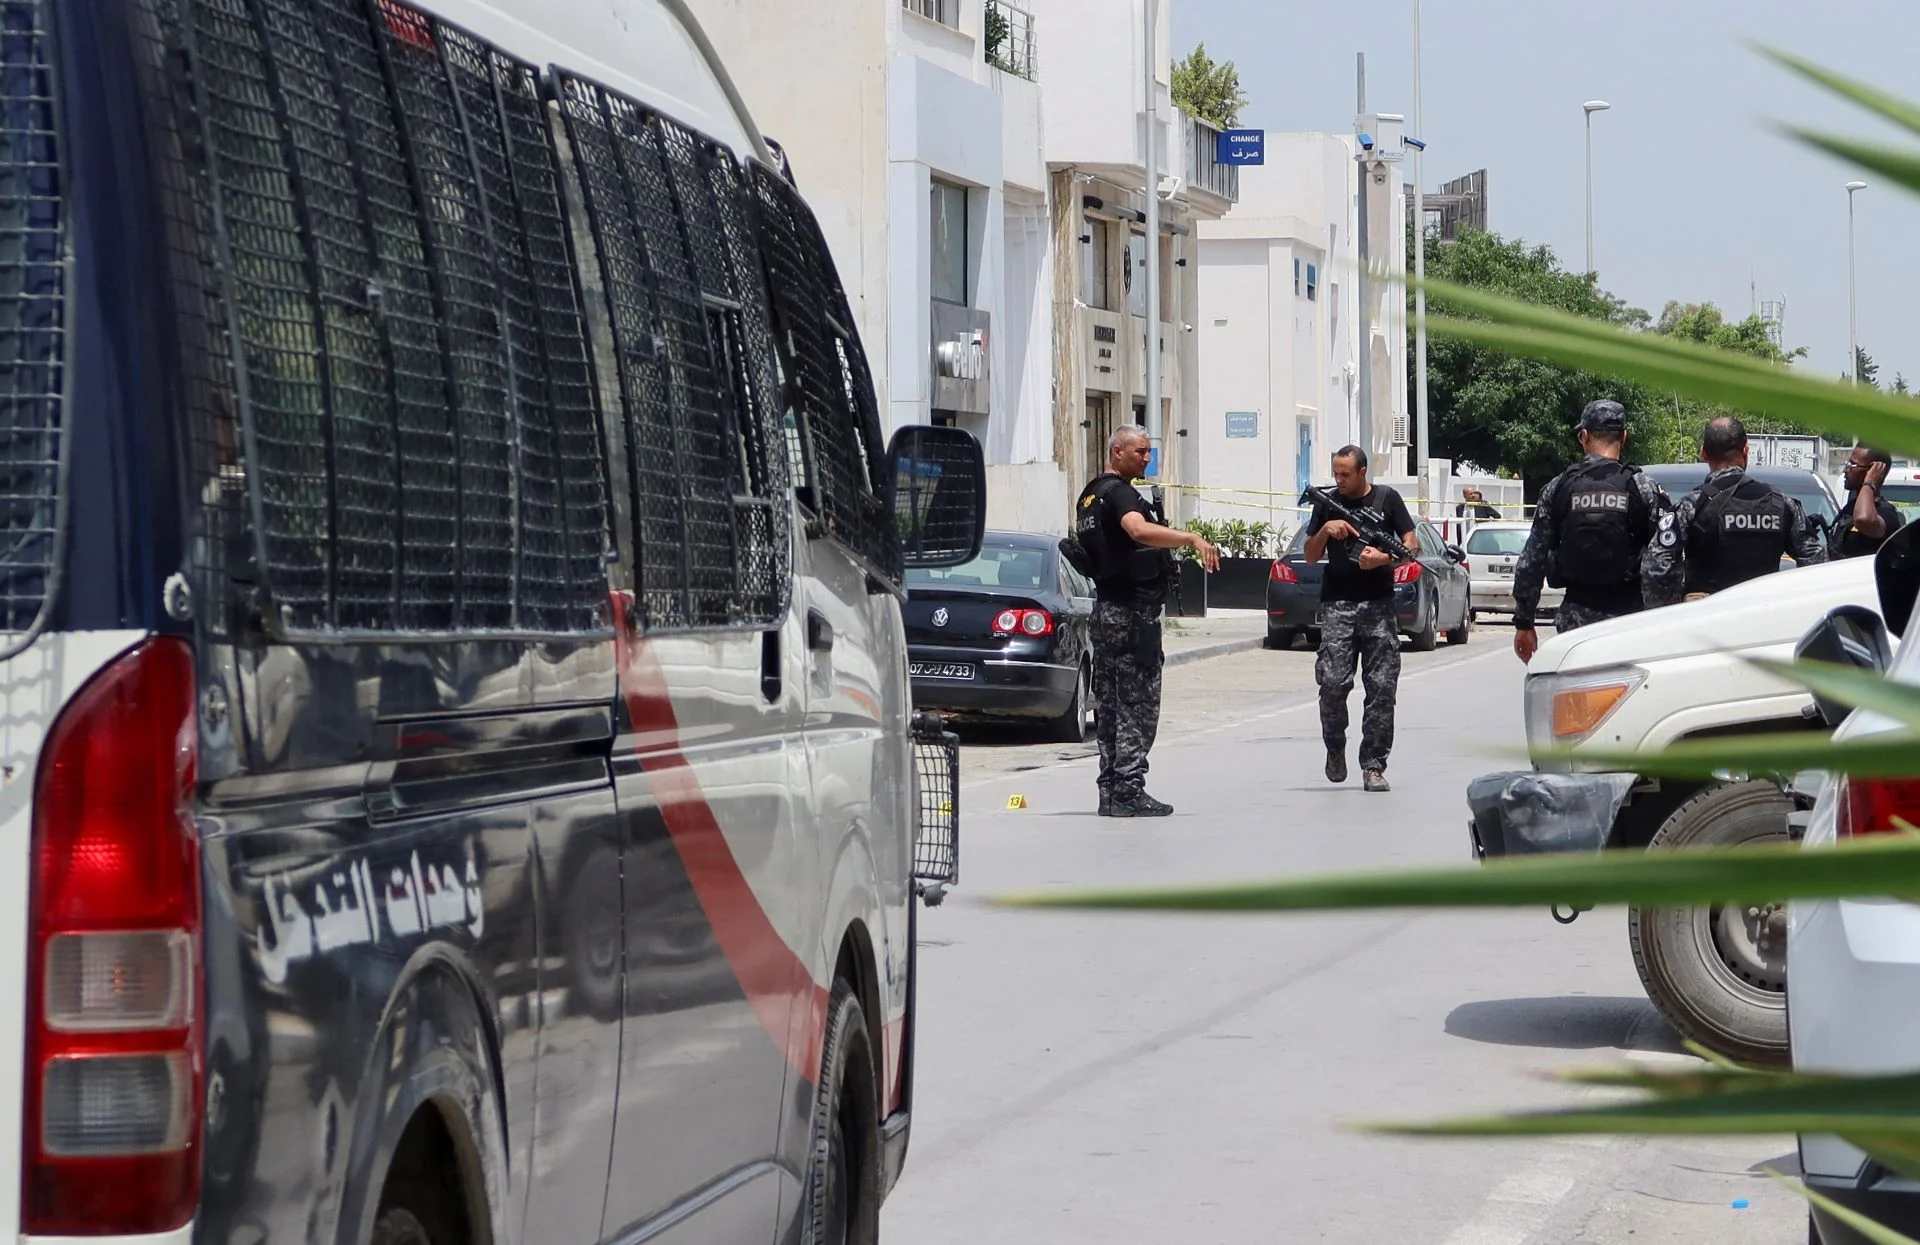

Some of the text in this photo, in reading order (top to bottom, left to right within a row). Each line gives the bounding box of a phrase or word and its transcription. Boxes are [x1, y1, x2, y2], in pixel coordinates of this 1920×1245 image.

[1230, 135, 1260, 143] CHANGE
[1231, 148, 1259, 159] صرف
[1571, 493, 1627, 511] POLICE
[1724, 514, 1780, 530] POLICE
[942, 665, 970, 677] 4733
[1010, 796, 1019, 806] 13
